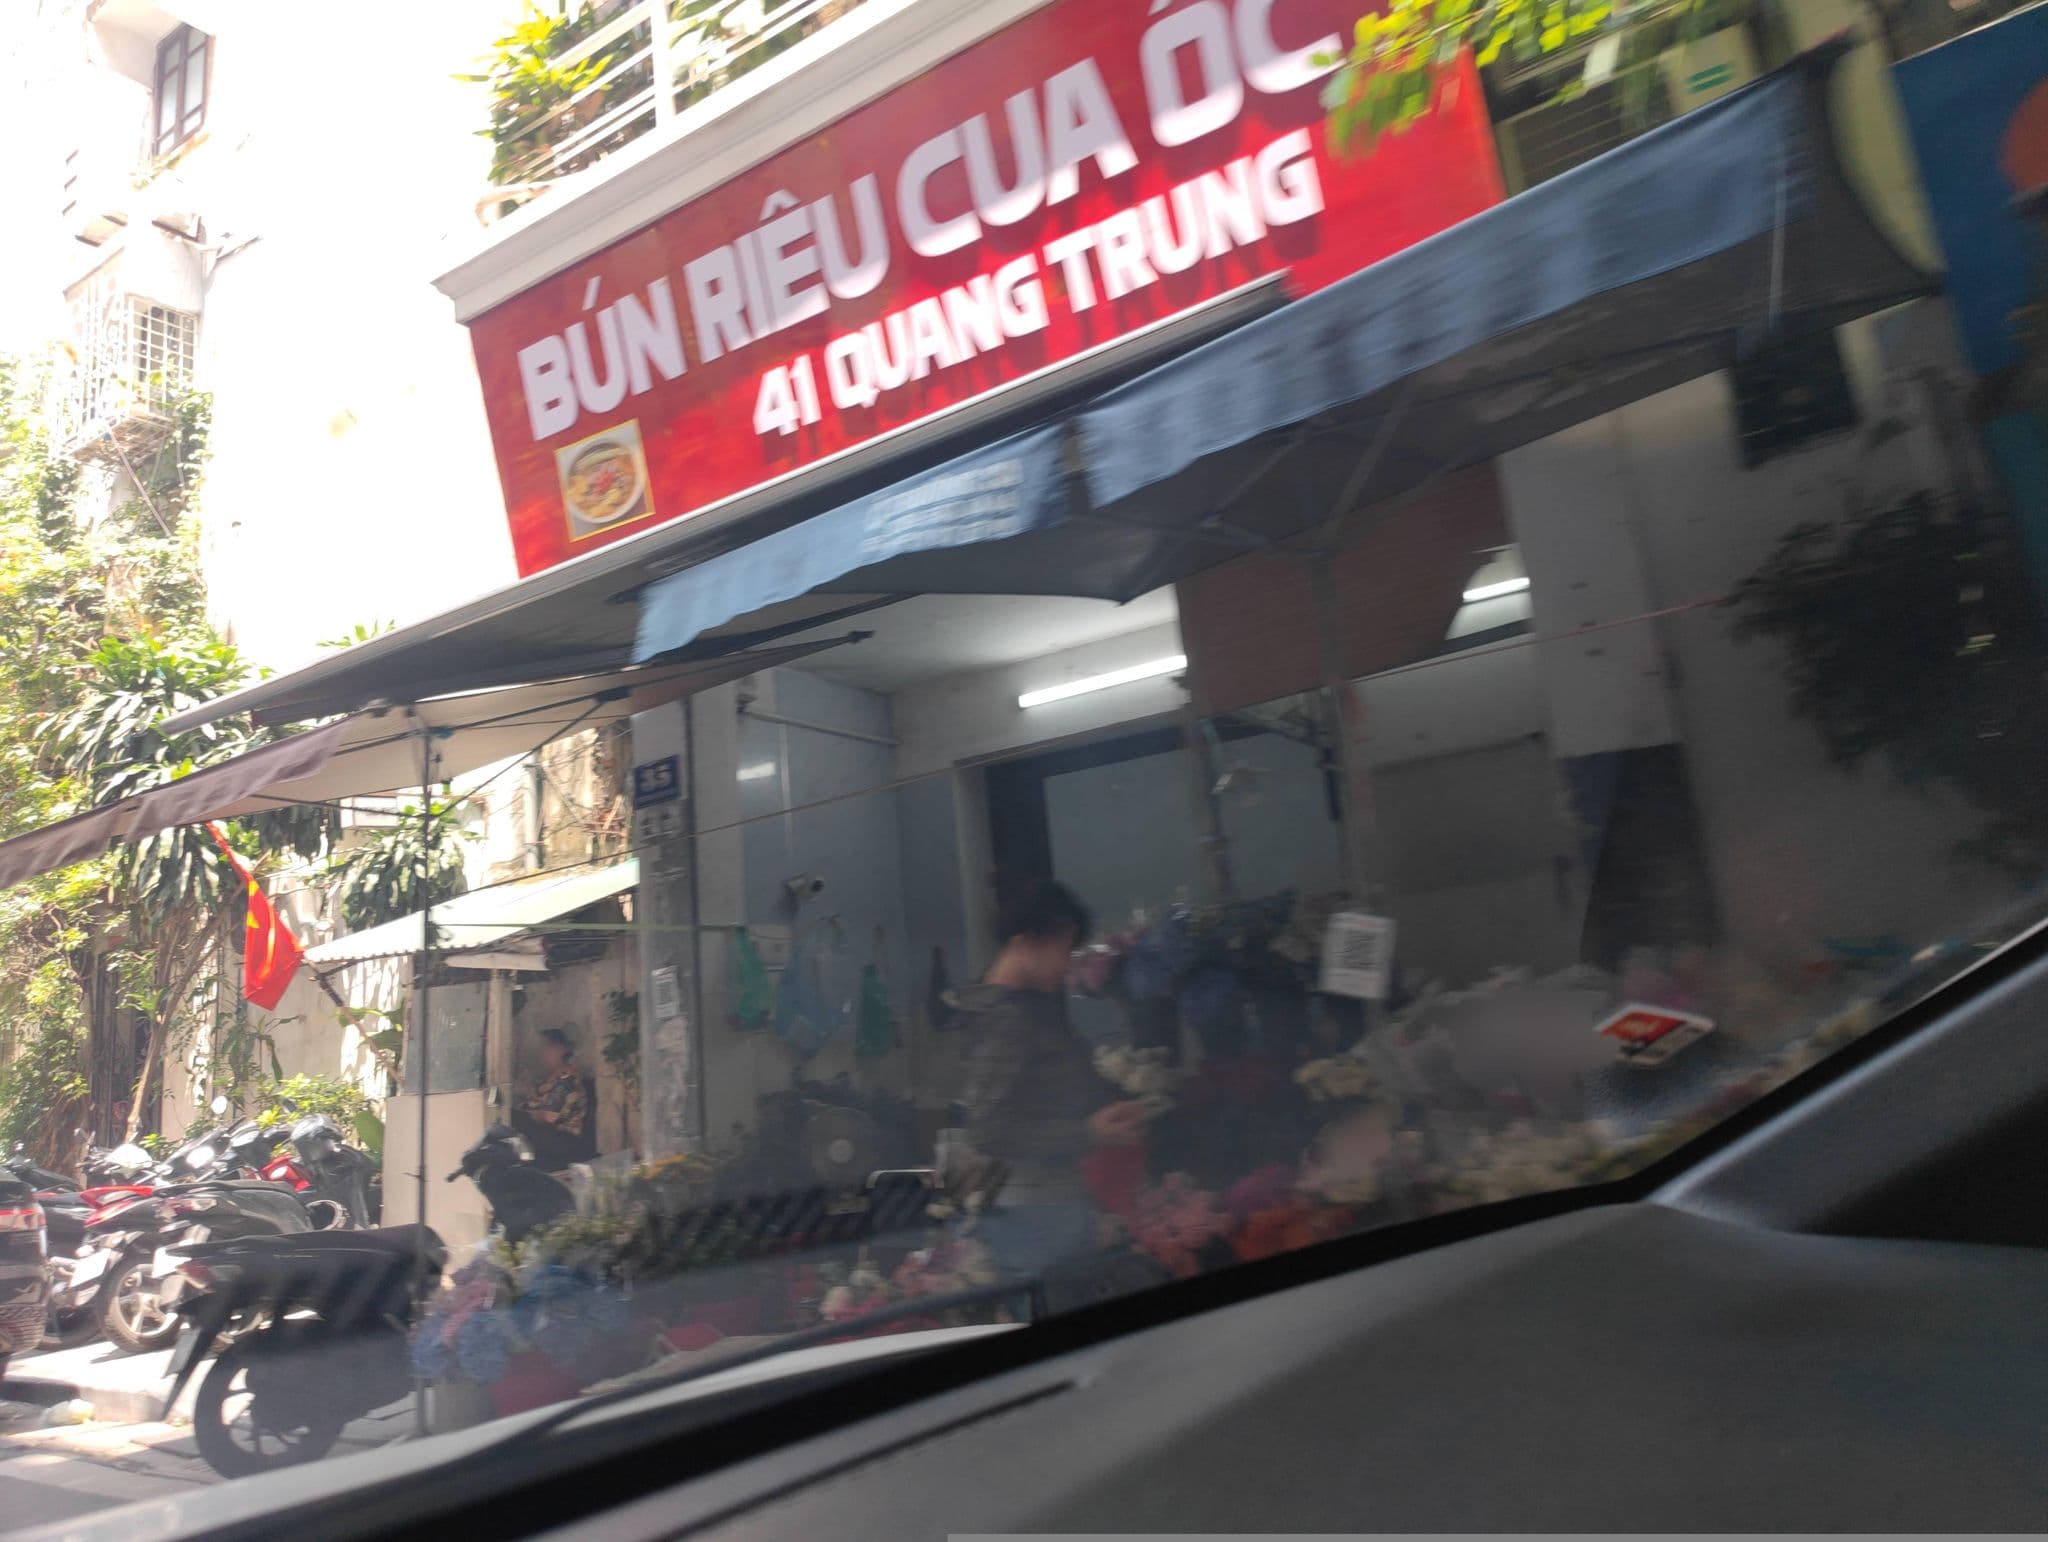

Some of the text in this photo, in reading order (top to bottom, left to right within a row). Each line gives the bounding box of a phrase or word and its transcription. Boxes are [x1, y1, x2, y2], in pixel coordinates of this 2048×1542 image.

[517, 275, 688, 442] BÚN
[683, 172, 892, 364] RIÊU
[895, 56, 1138, 258] CUA
[752, 127, 1326, 437] 41 QUANG TRUNG
